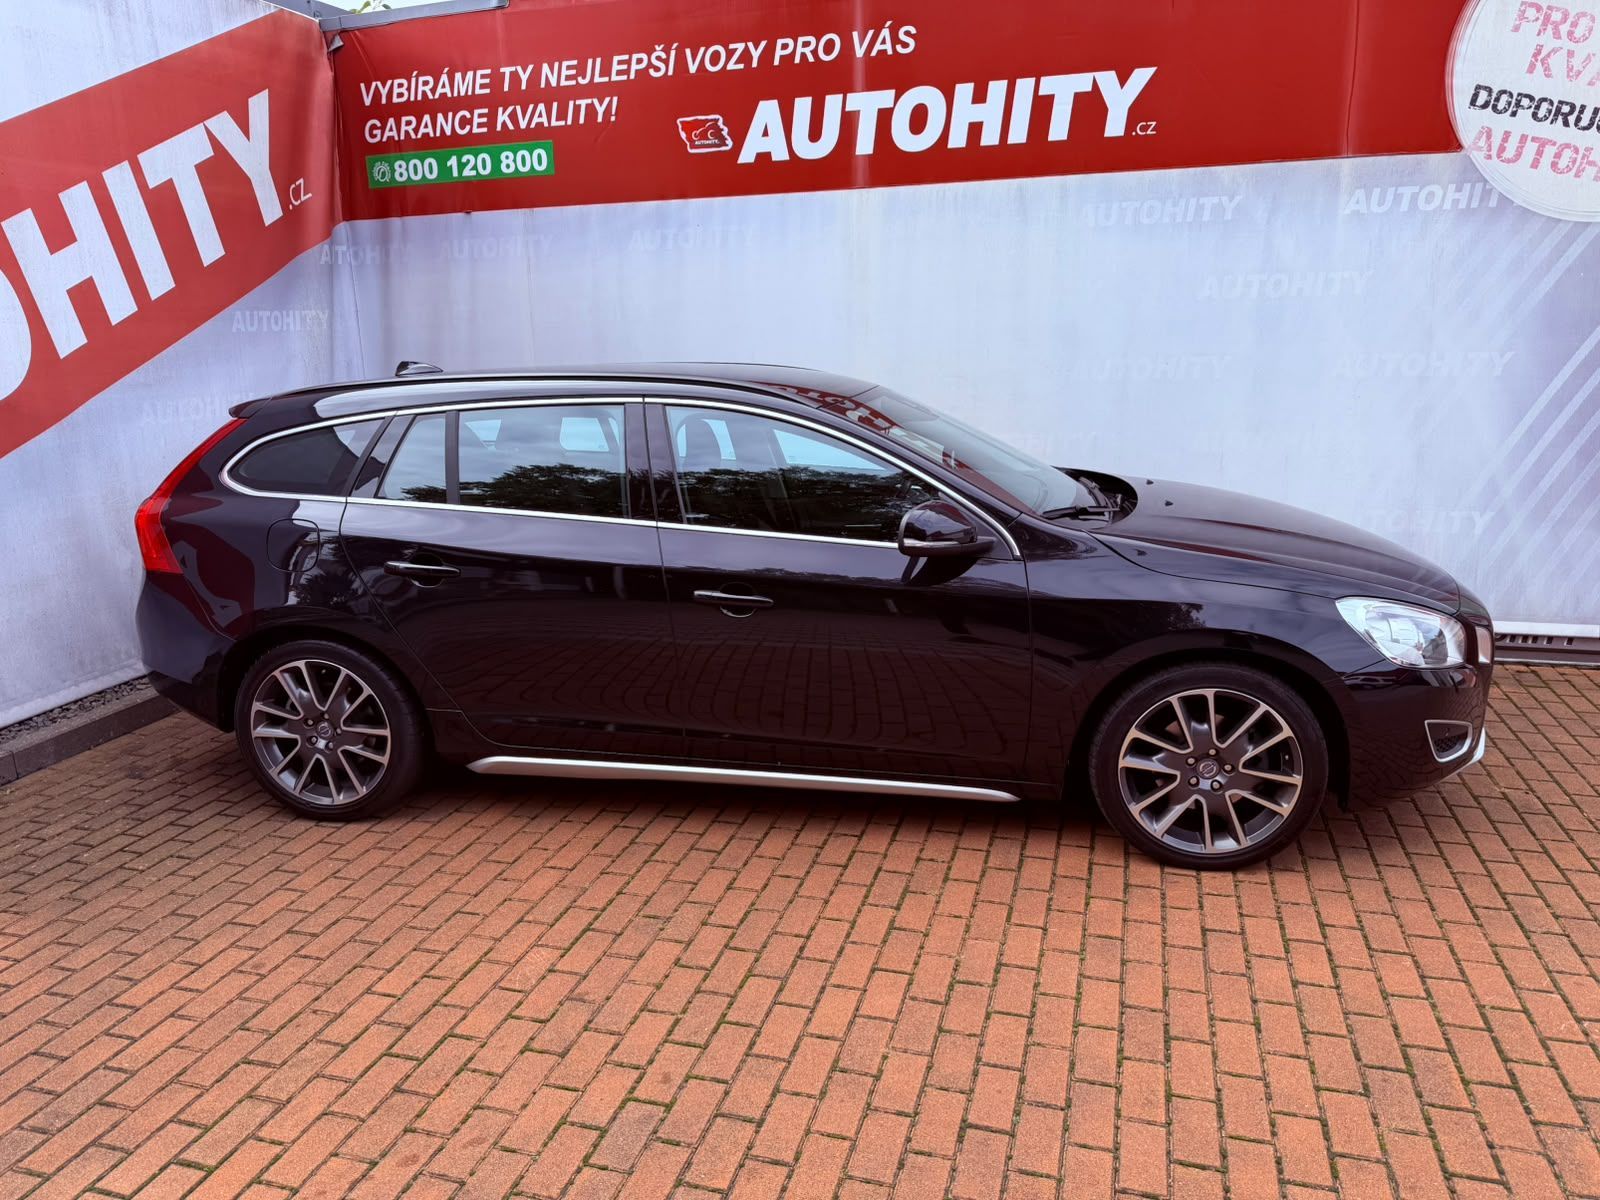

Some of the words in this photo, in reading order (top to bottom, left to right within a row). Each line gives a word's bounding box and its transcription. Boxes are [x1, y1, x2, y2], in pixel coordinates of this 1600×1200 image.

[1510, 0, 1597, 44] PRO
[360, 67, 491, 107] VYBÍRÁME
[499, 65, 534, 92] TY
[540, 43, 678, 88] NEJLEPŠÍ
[685, 40, 768, 75] VOZY
[773, 33, 841, 66] PRO
[852, 21, 918, 58] VÁS
[364, 109, 488, 144] GARANCE
[496, 96, 618, 132] KVALITY!
[393, 157, 439, 183] 800
[446, 153, 492, 178] 120
[500, 148, 548, 174] 800
[1343, 182, 1506, 215] AUTOHIT
[231, 310, 329, 333] AUTOHITY
